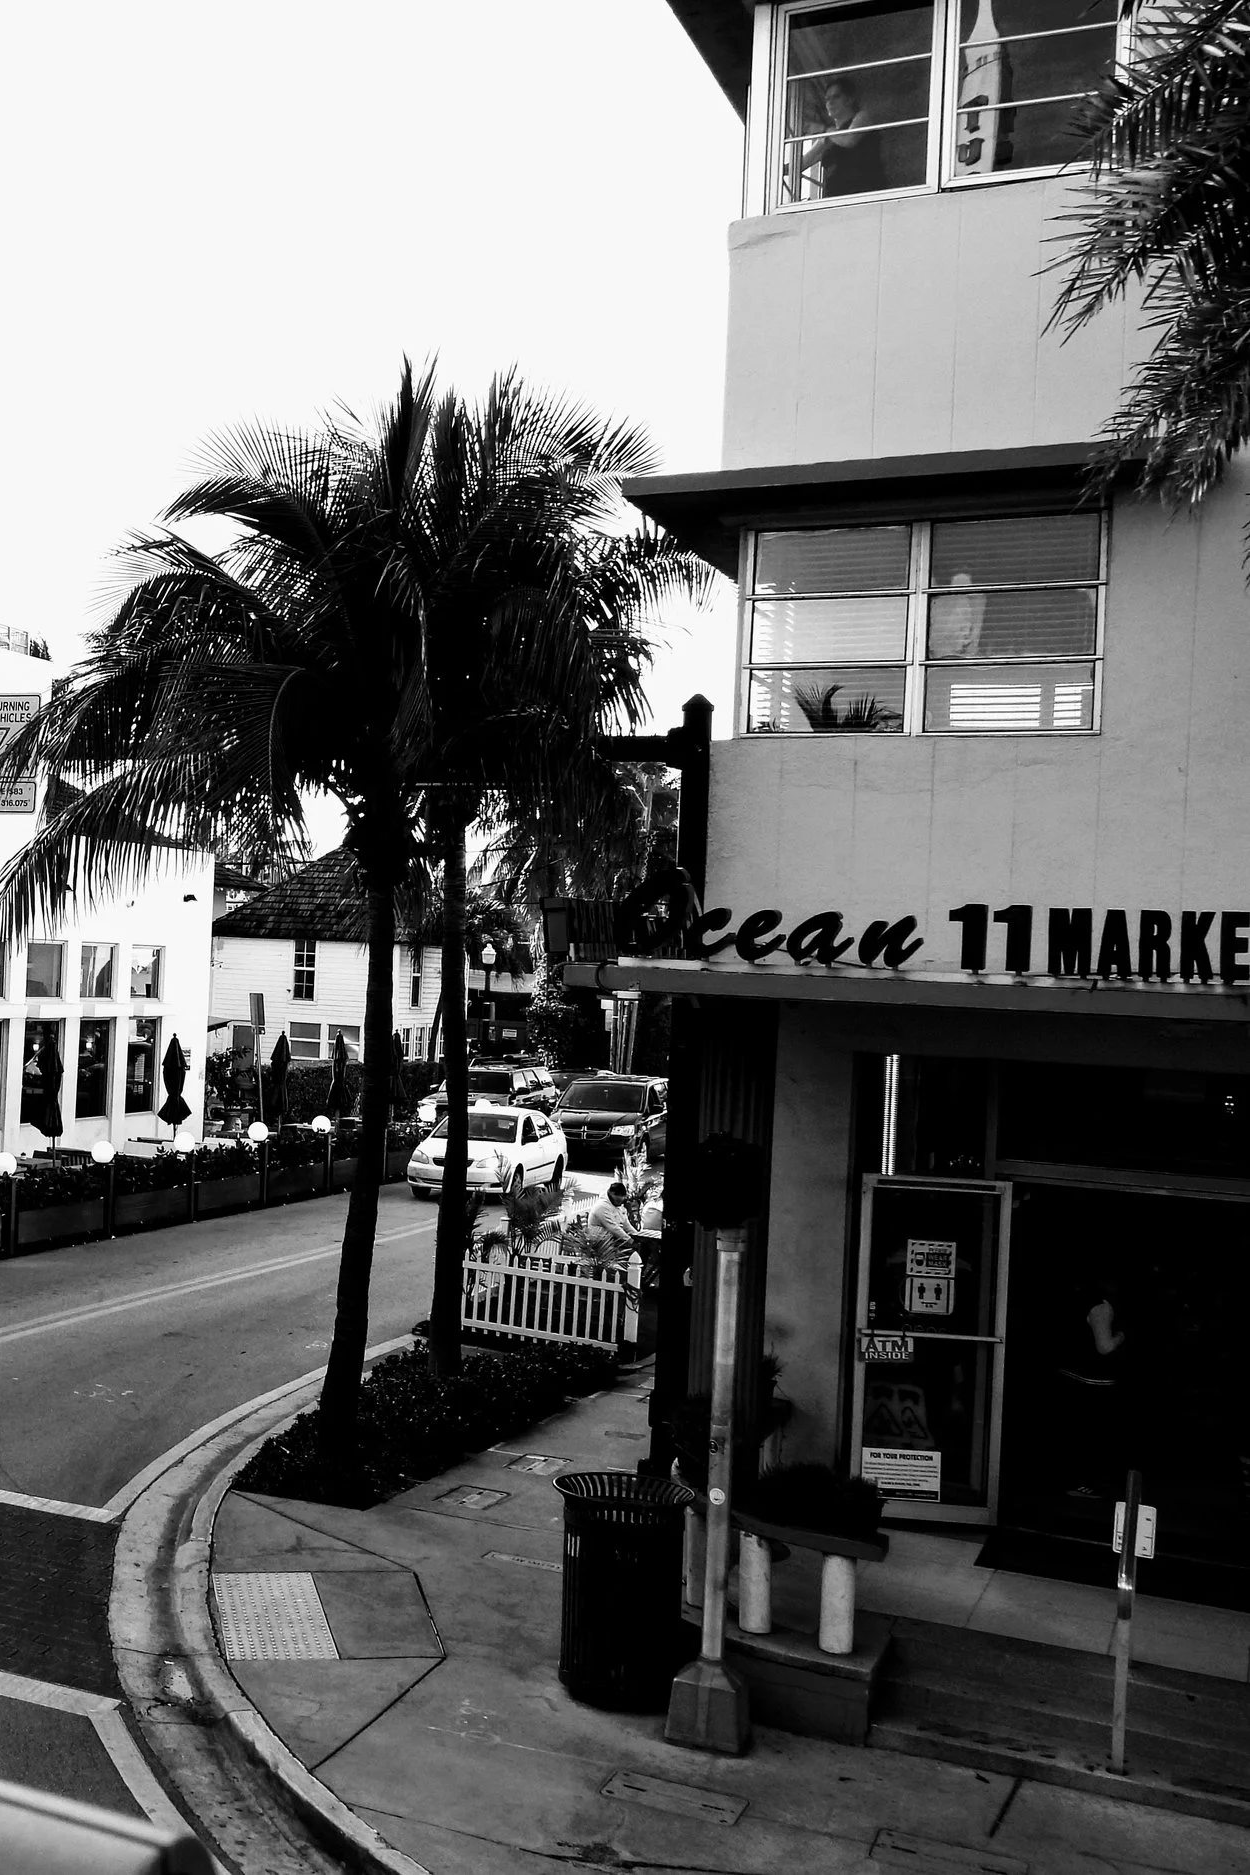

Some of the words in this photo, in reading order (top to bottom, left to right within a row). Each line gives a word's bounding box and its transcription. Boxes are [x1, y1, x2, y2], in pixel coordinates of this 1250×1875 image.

[616, 866, 925, 967] Ocean
[949, 903, 1034, 973] 11
[1048, 907, 1250, 984] MARKE
[865, 1339, 909, 1352] ATM
[865, 1351, 910, 1360] INSIDE
